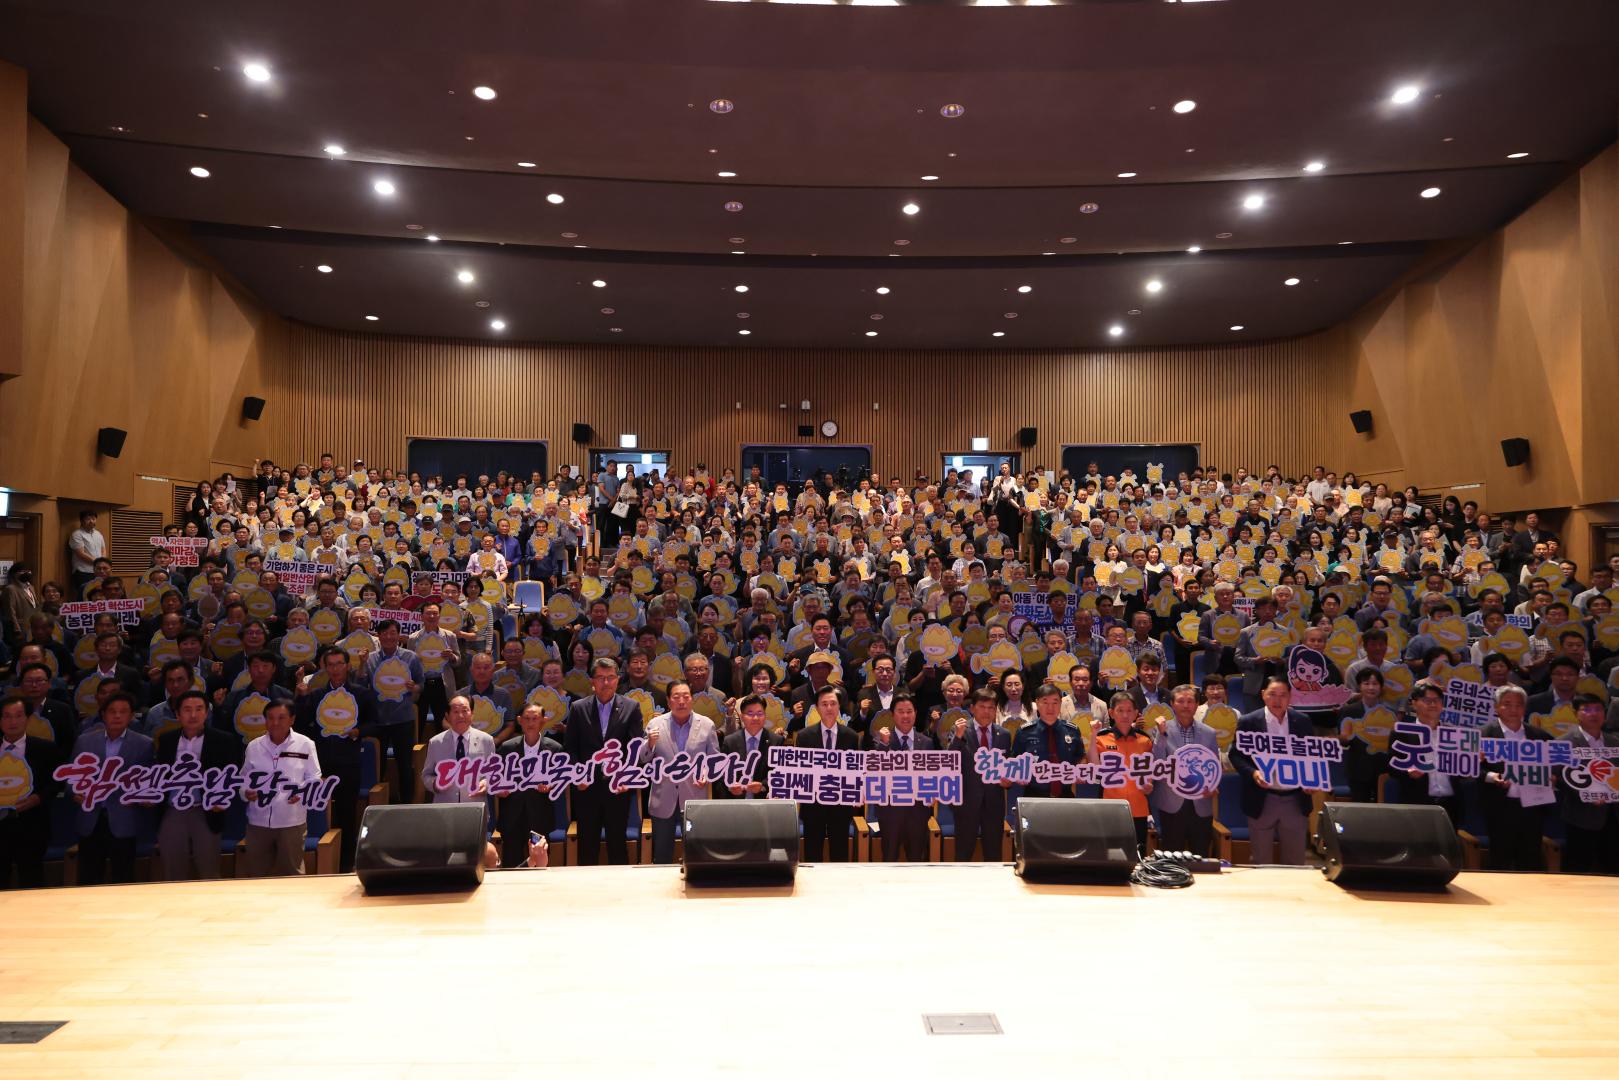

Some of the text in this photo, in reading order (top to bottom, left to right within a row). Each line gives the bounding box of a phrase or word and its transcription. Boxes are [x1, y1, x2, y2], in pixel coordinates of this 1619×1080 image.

[170, 556, 198, 566] 가정원
[266, 561, 332, 574] 기업하기 좋은 도시
[288, 584, 305, 594] 조성
[62, 600, 143, 614] 스마트농업 혁신도시
[379, 611, 409, 621] 500만명
[401, 622, 421, 635] 러와
[1449, 680, 1497, 700] 유네스
[1444, 694, 1491, 716] 계유산
[1238, 733, 1340, 759] 부여로 놀러와
[770, 749, 960, 772] 대한민국의 힘! 충남의 원동력!
[977, 750, 1176, 786] 함께 만드는 더 큰 부여
[437, 752, 593, 798] 대한민국의
[1256, 757, 1329, 789] YOU!
[1504, 765, 1550, 787] 사비
[770, 772, 961, 805] 힘쎈 충남 더 큰 부여
